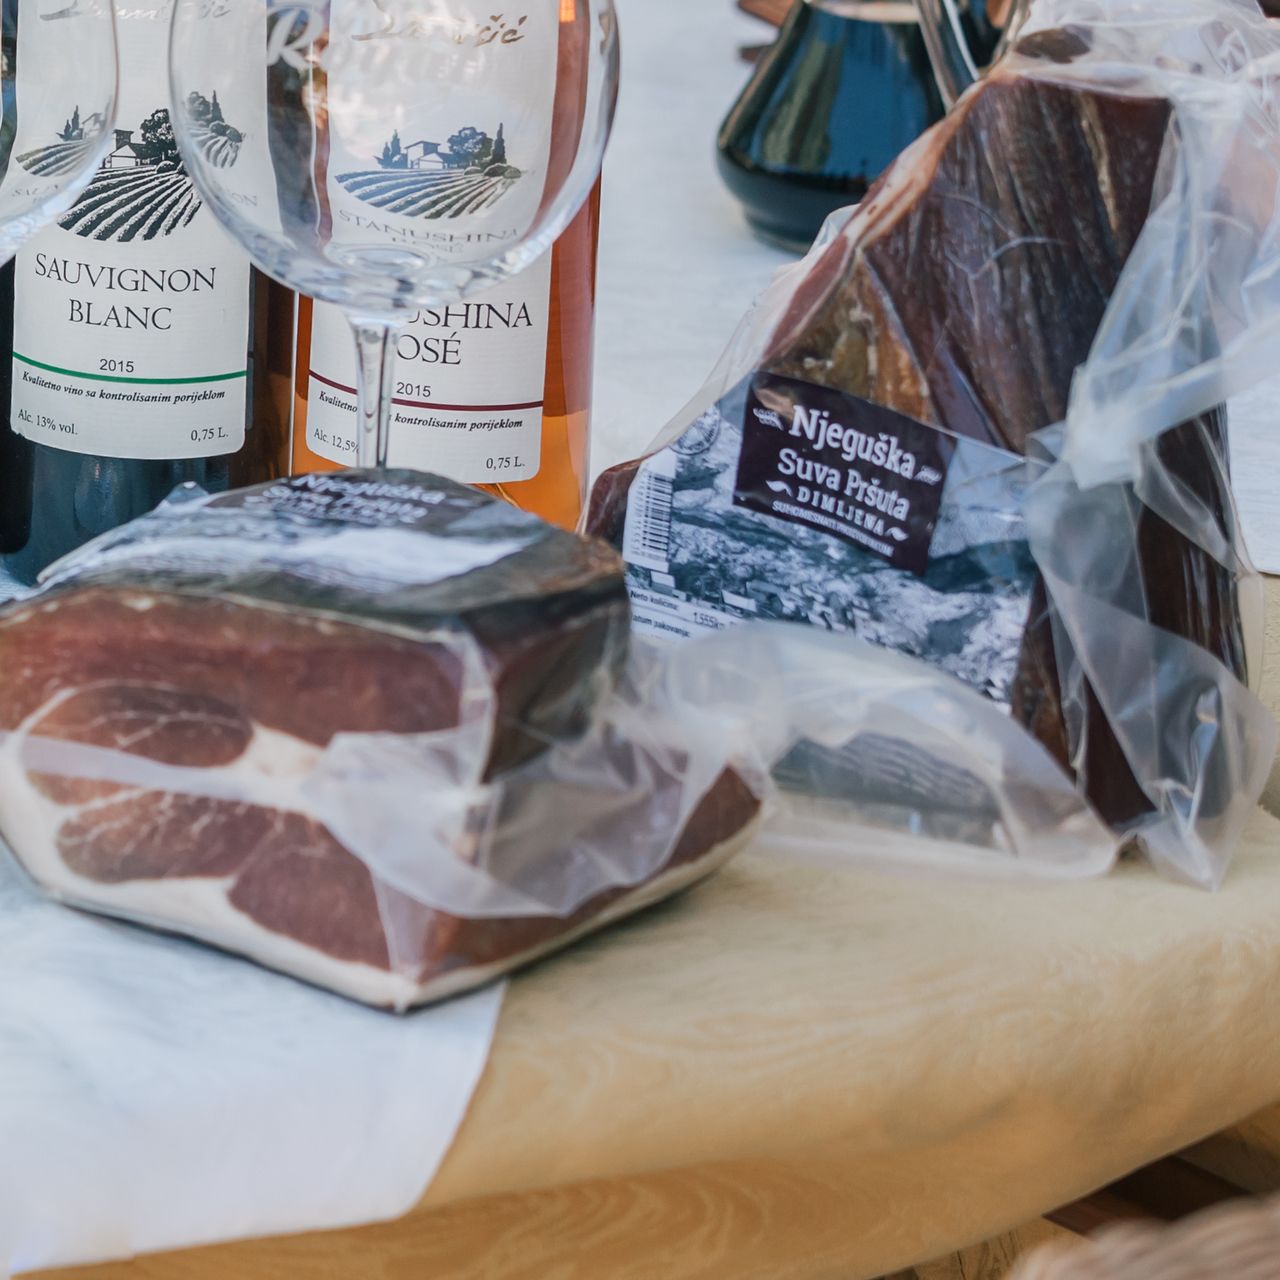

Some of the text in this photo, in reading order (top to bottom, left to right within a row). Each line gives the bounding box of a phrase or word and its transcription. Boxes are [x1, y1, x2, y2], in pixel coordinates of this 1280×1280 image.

[35, 253, 216, 292] SAUVIGNON
[68, 298, 172, 330] BLANC
[397, 332, 462, 365] OSÉ
[99, 359, 135, 373] 2015
[22, 371, 225, 404] Kvalitetno vino sa kontrolisanim porijeklom
[396, 382, 432, 398] 2015
[319, 390, 358, 413] Kvalitetno
[18, 409, 78, 435] Alc. 13% vol.
[190, 427, 229, 442] 0,75 L.
[395, 413, 467, 429] kontrolisanim
[469, 417, 523, 431] porijeklom
[314, 427, 329, 444] Alc.
[788, 404, 916, 480] Njeguška
[486, 455, 525, 472] 0,75 L.
[777, 448, 910, 521] Suva Pršuta
[797, 486, 885, 536] DIMLJENA
